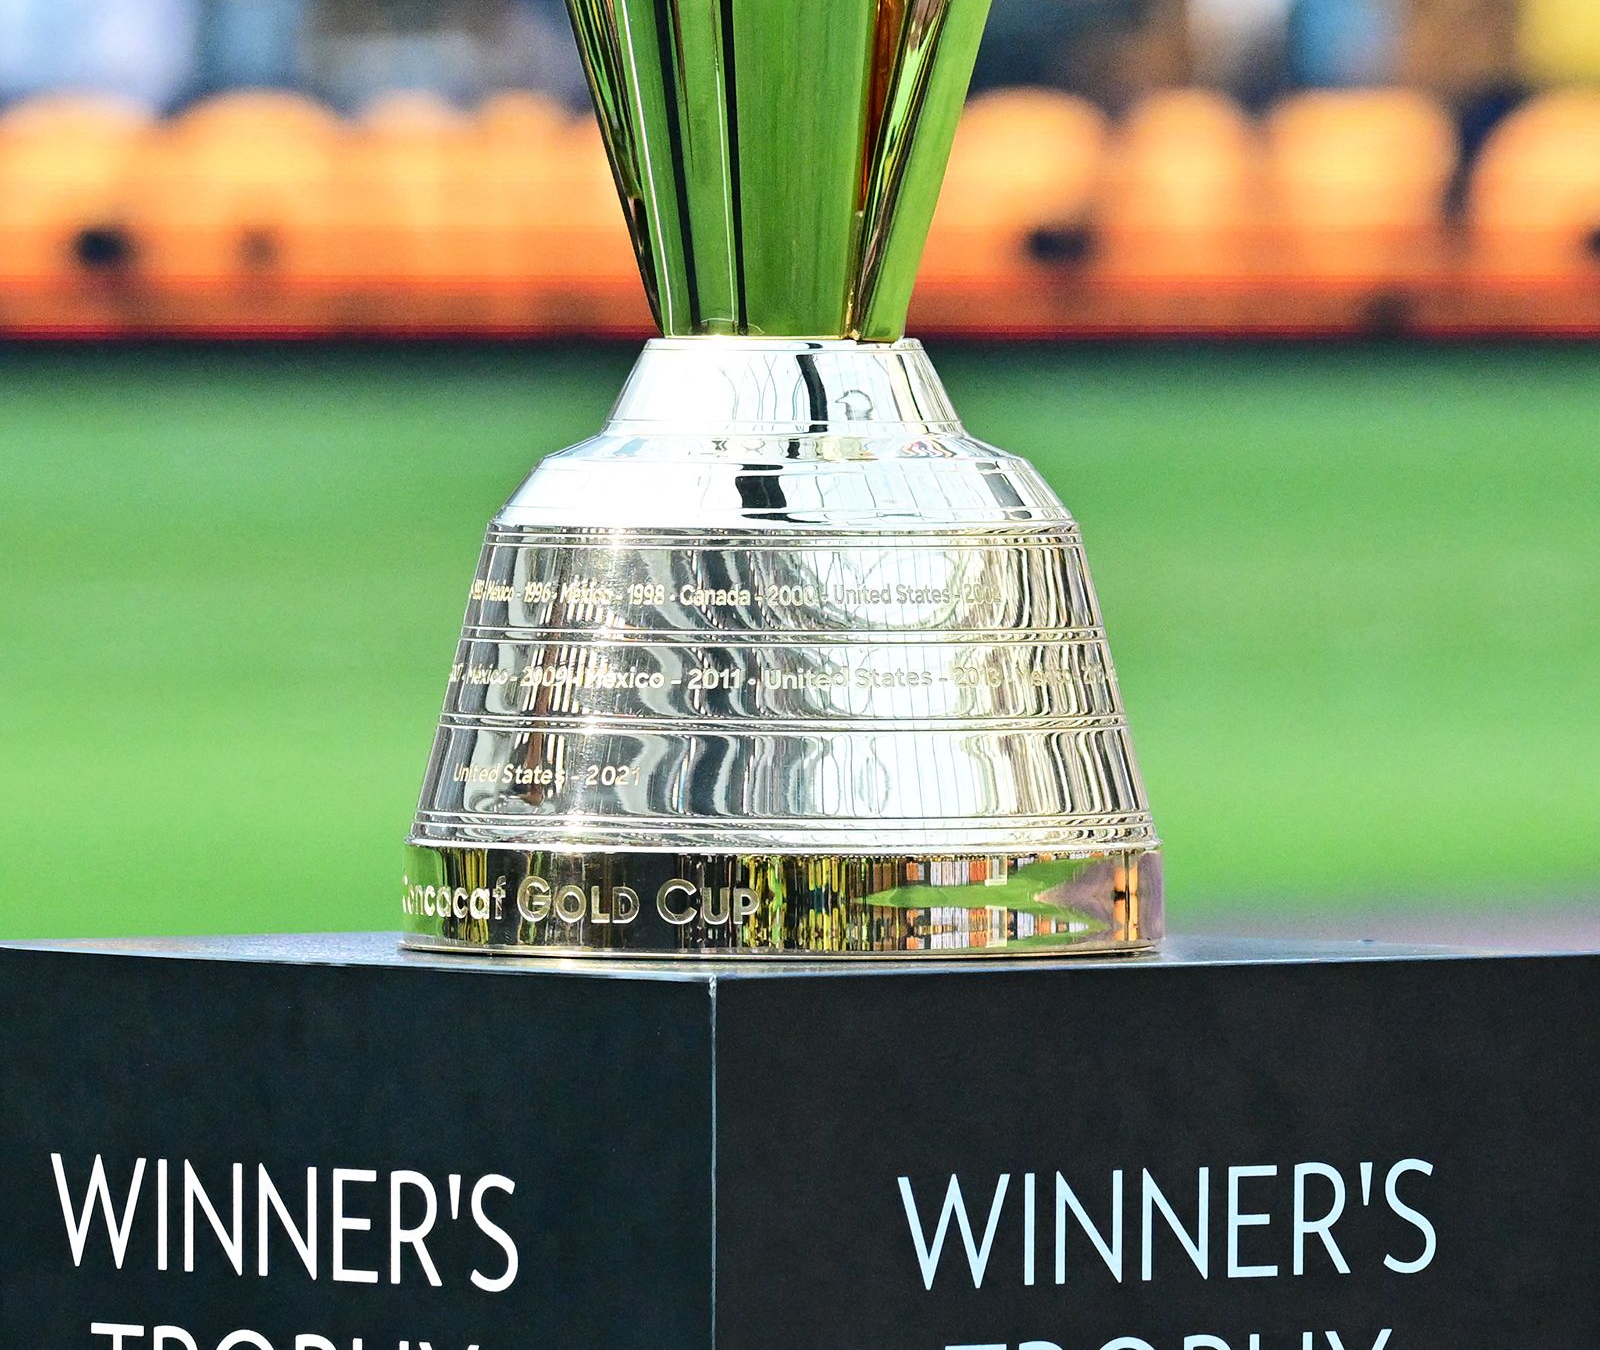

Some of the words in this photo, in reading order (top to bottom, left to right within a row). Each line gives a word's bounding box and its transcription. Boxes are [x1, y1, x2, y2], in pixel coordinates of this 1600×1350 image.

[524, 581, 552, 603] 1996
[628, 584, 665, 606] 1998
[680, 584, 751, 606] Canada
[767, 585, 817, 606] 2000
[833, 584, 892, 605] United
[896, 584, 950, 605] States
[520, 665, 567, 687] 2009
[688, 668, 740, 690] 2011
[765, 667, 848, 690] United
[854, 667, 932, 689] States
[453, 762, 500, 783] United
[502, 763, 566, 785] States
[585, 764, 641, 786] 2021
[516, 875, 641, 924] GOLD
[656, 878, 761, 925] CUP
[51, 1153, 518, 1292] WINNER'S
[898, 1158, 1436, 1290] WINNER'S
